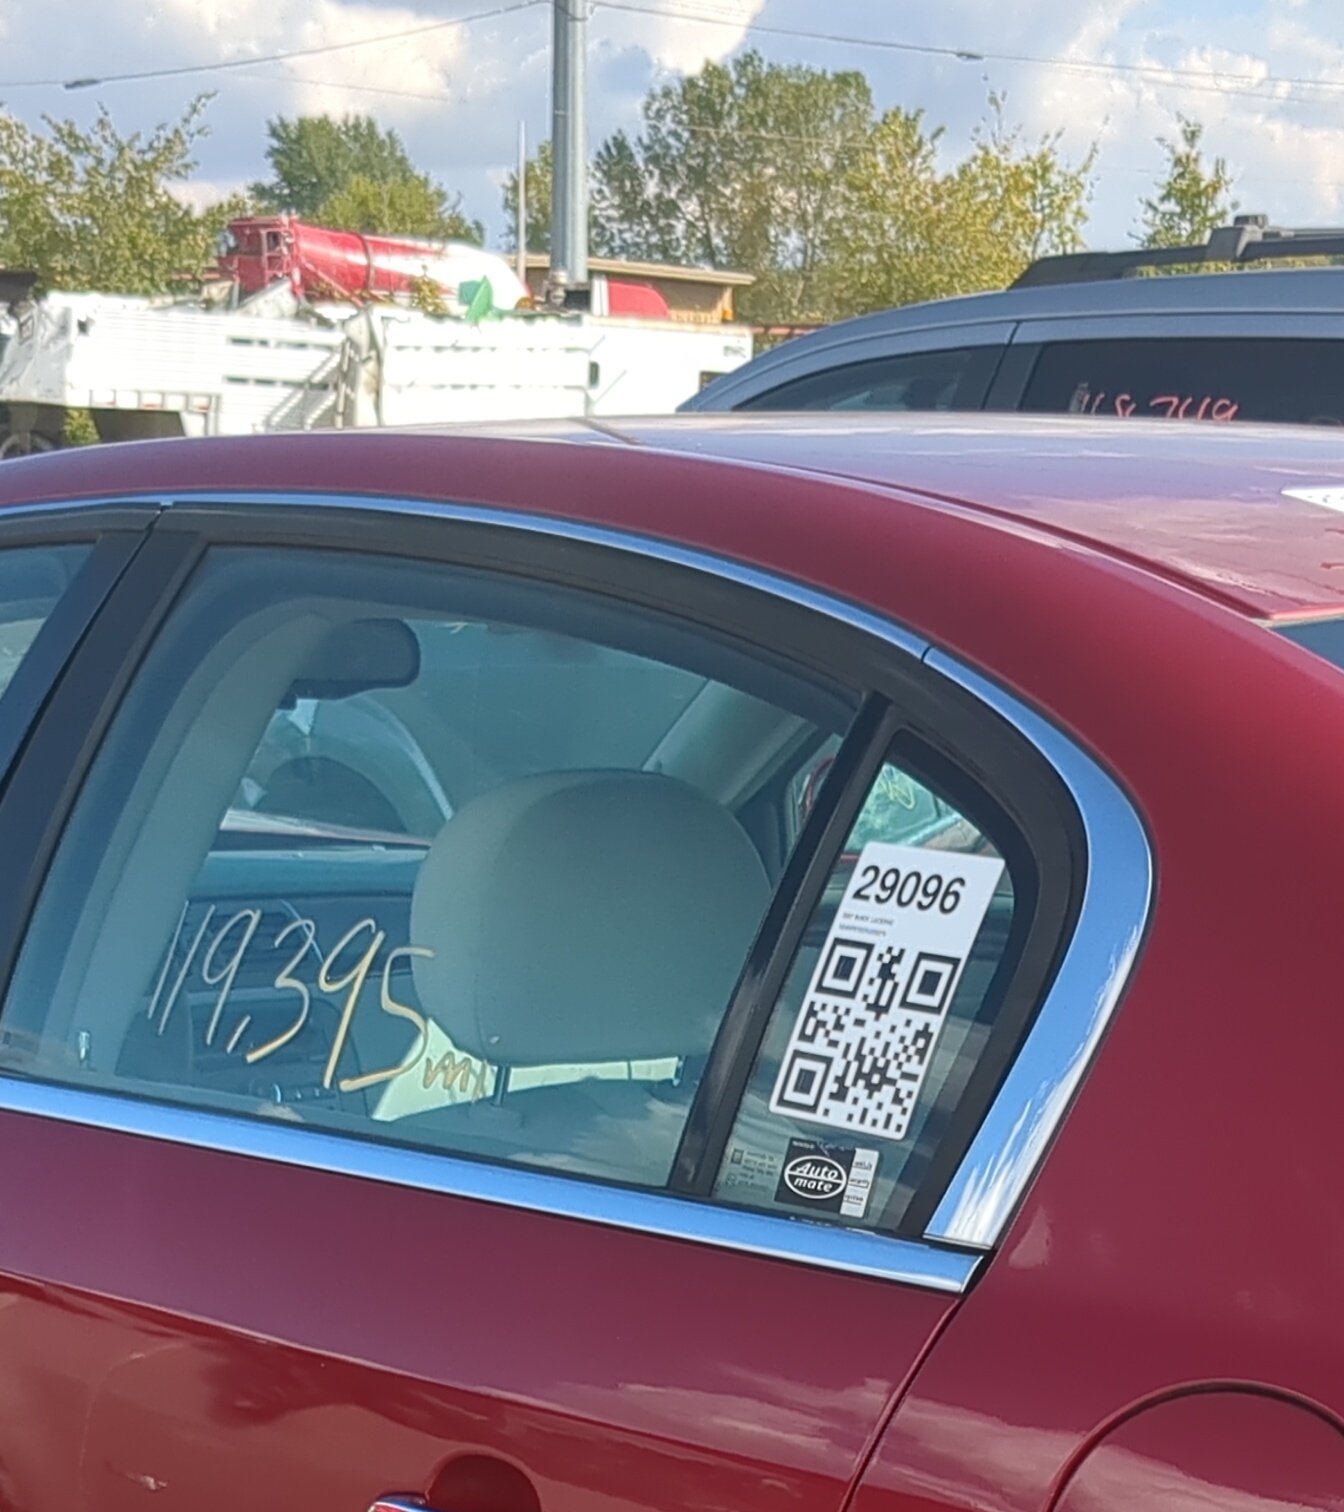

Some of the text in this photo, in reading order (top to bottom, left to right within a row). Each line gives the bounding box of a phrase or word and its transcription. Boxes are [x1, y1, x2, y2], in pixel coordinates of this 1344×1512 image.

[852, 865, 966, 915] 29096
[796, 1162, 839, 1180] Auto
[794, 1177, 833, 1193] mate
